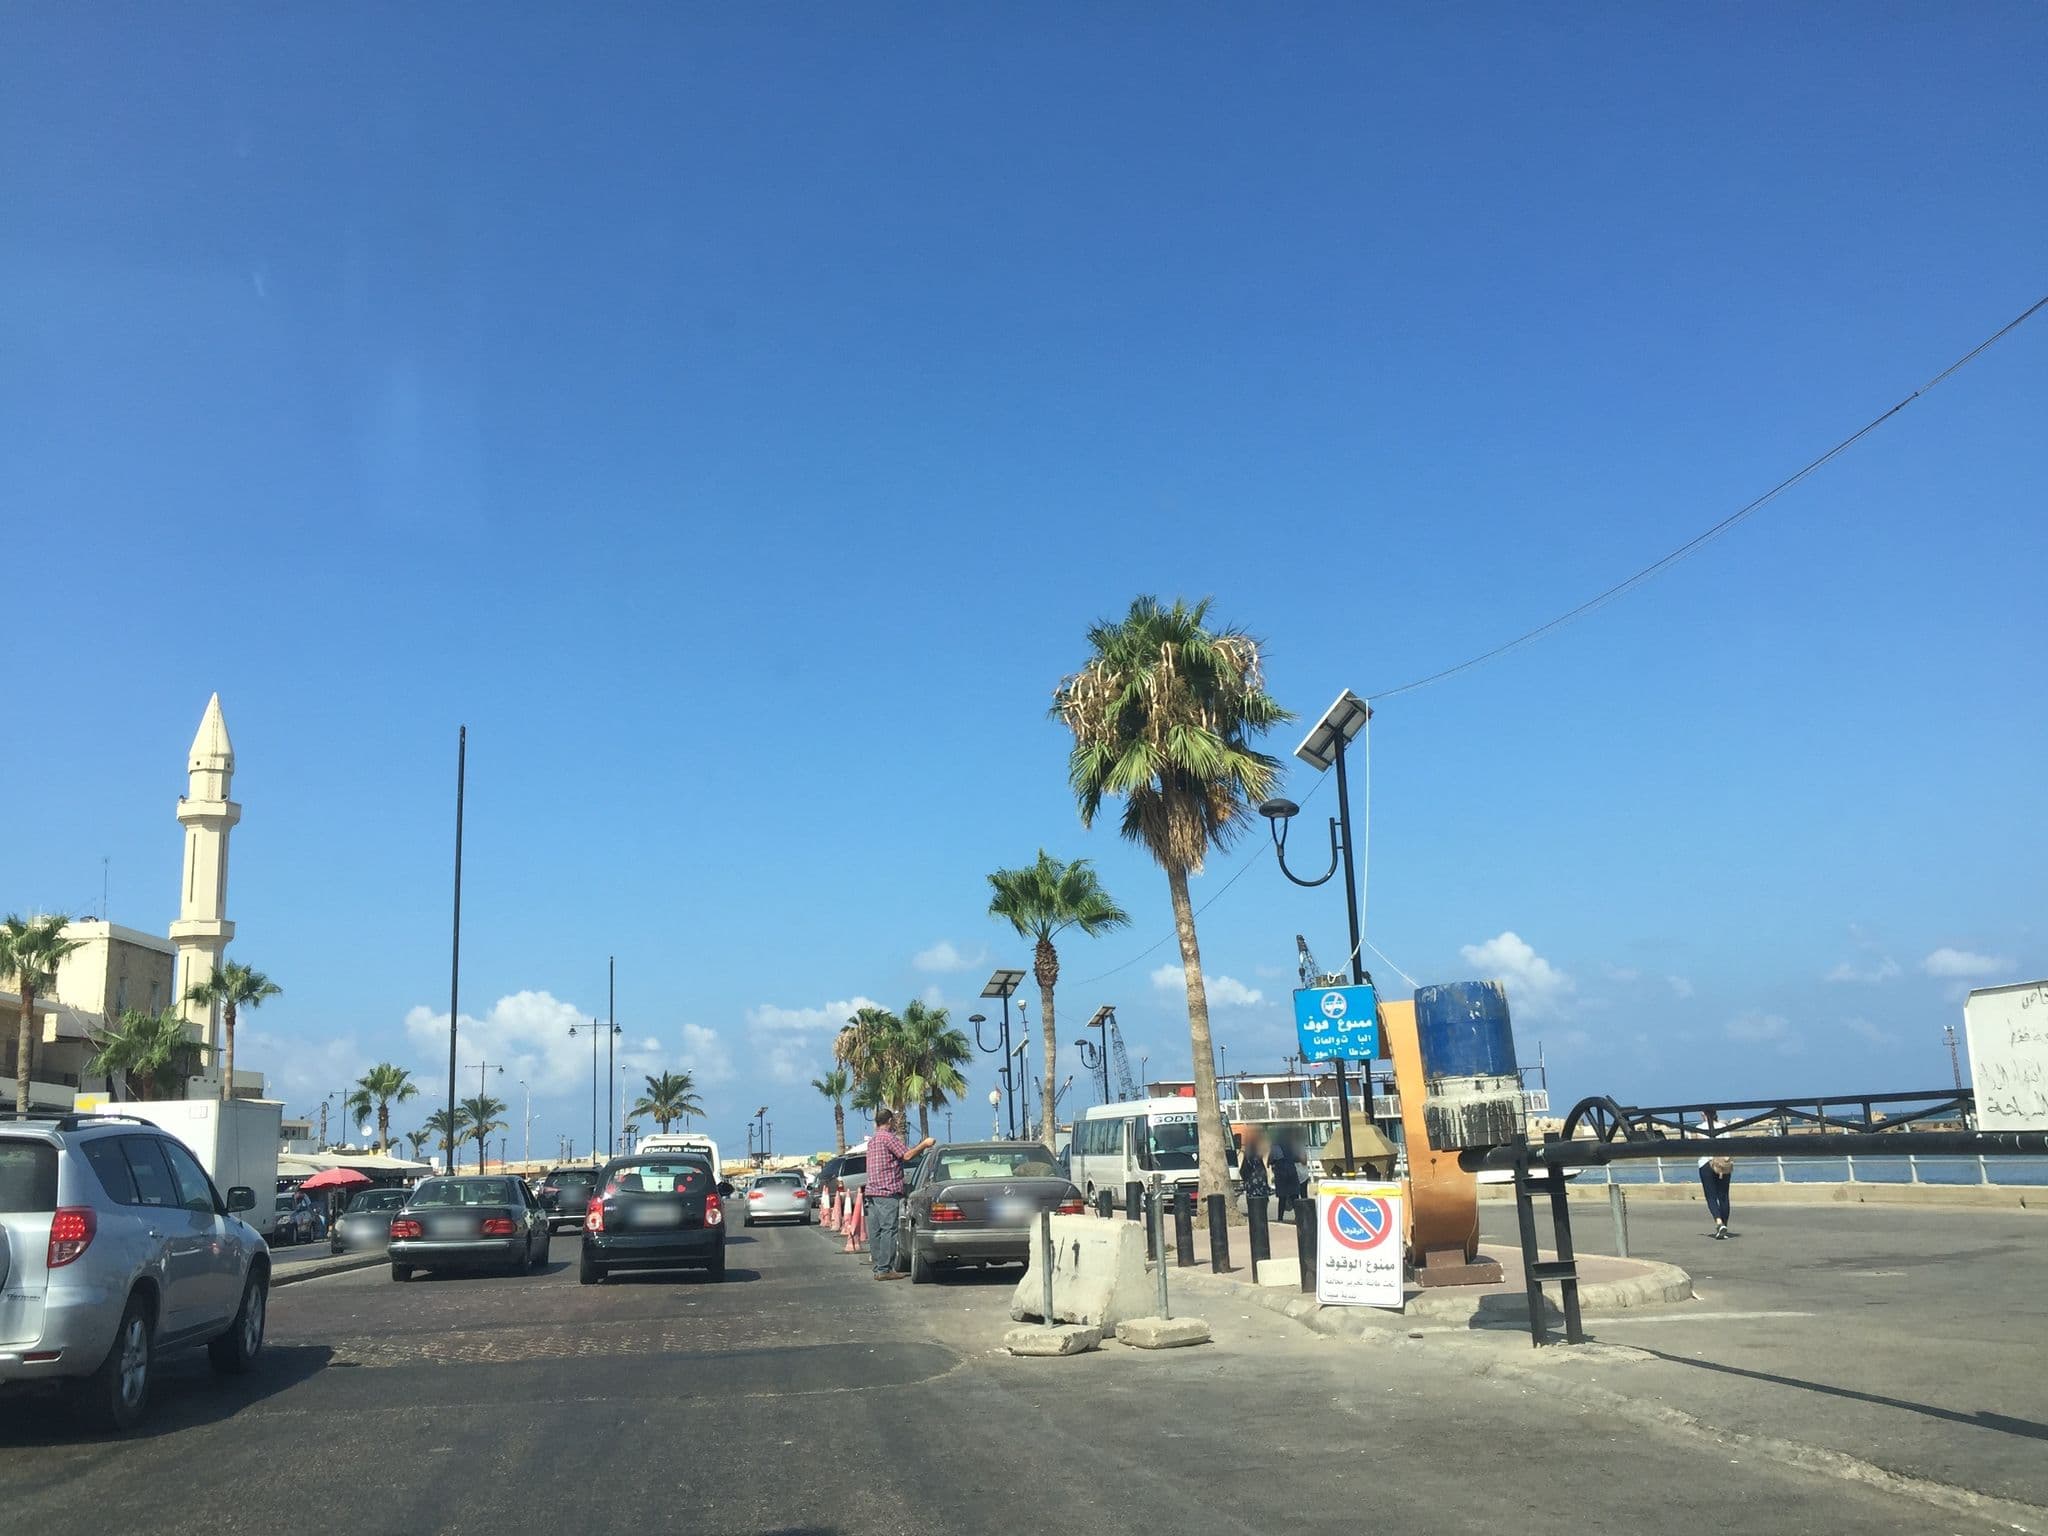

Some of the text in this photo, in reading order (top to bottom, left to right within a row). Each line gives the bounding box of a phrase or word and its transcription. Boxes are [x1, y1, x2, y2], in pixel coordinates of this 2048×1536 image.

[1153, 1115, 1184, 1124] GOD
[1326, 1256, 1395, 1273] ممنوع الوقوف
